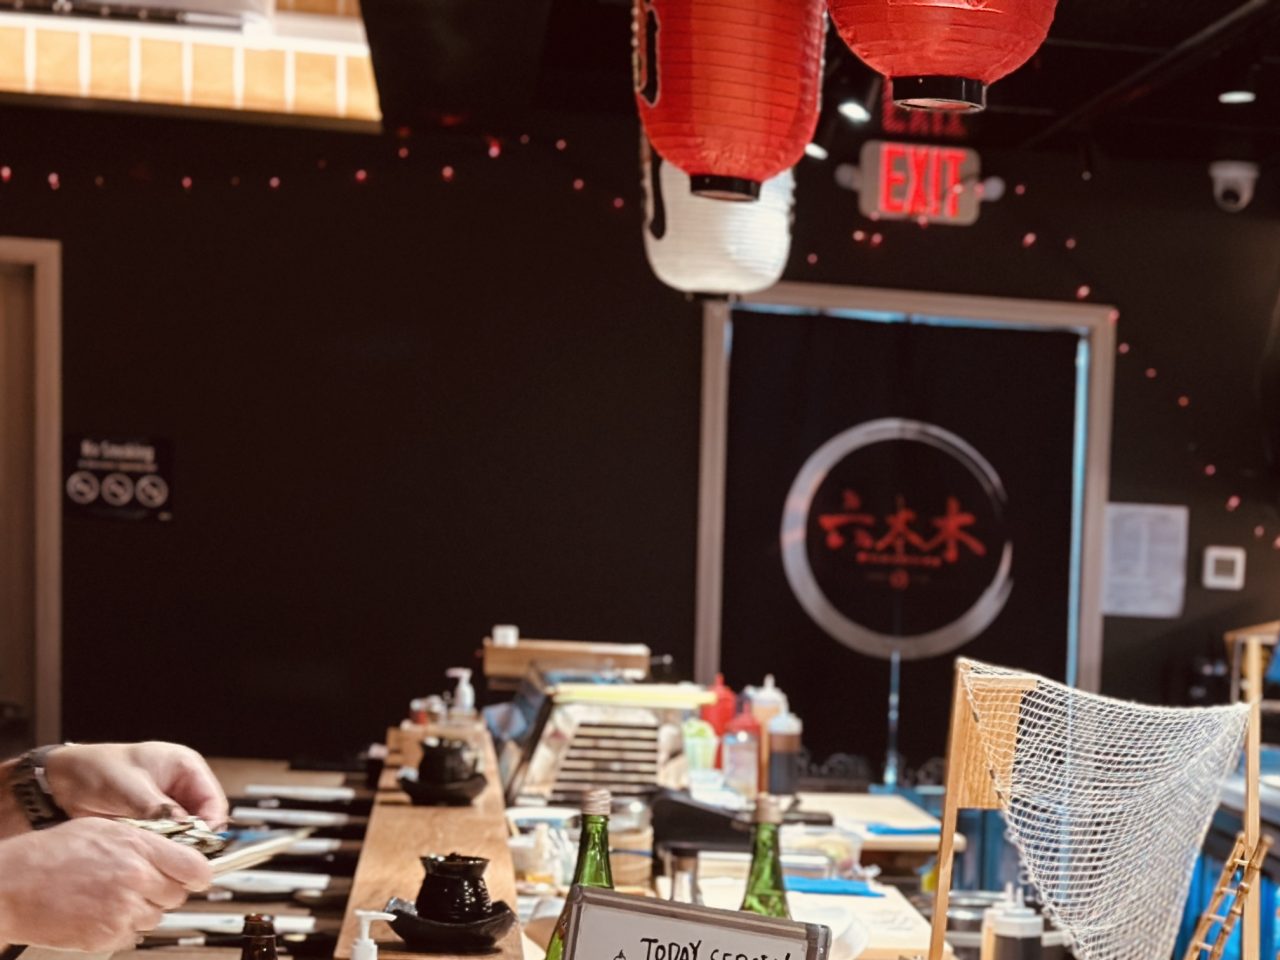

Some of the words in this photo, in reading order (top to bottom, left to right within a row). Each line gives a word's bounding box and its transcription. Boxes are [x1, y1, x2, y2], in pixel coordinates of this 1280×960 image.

[883, 143, 967, 218] EXIT
[819, 489, 987, 563] 六本木
